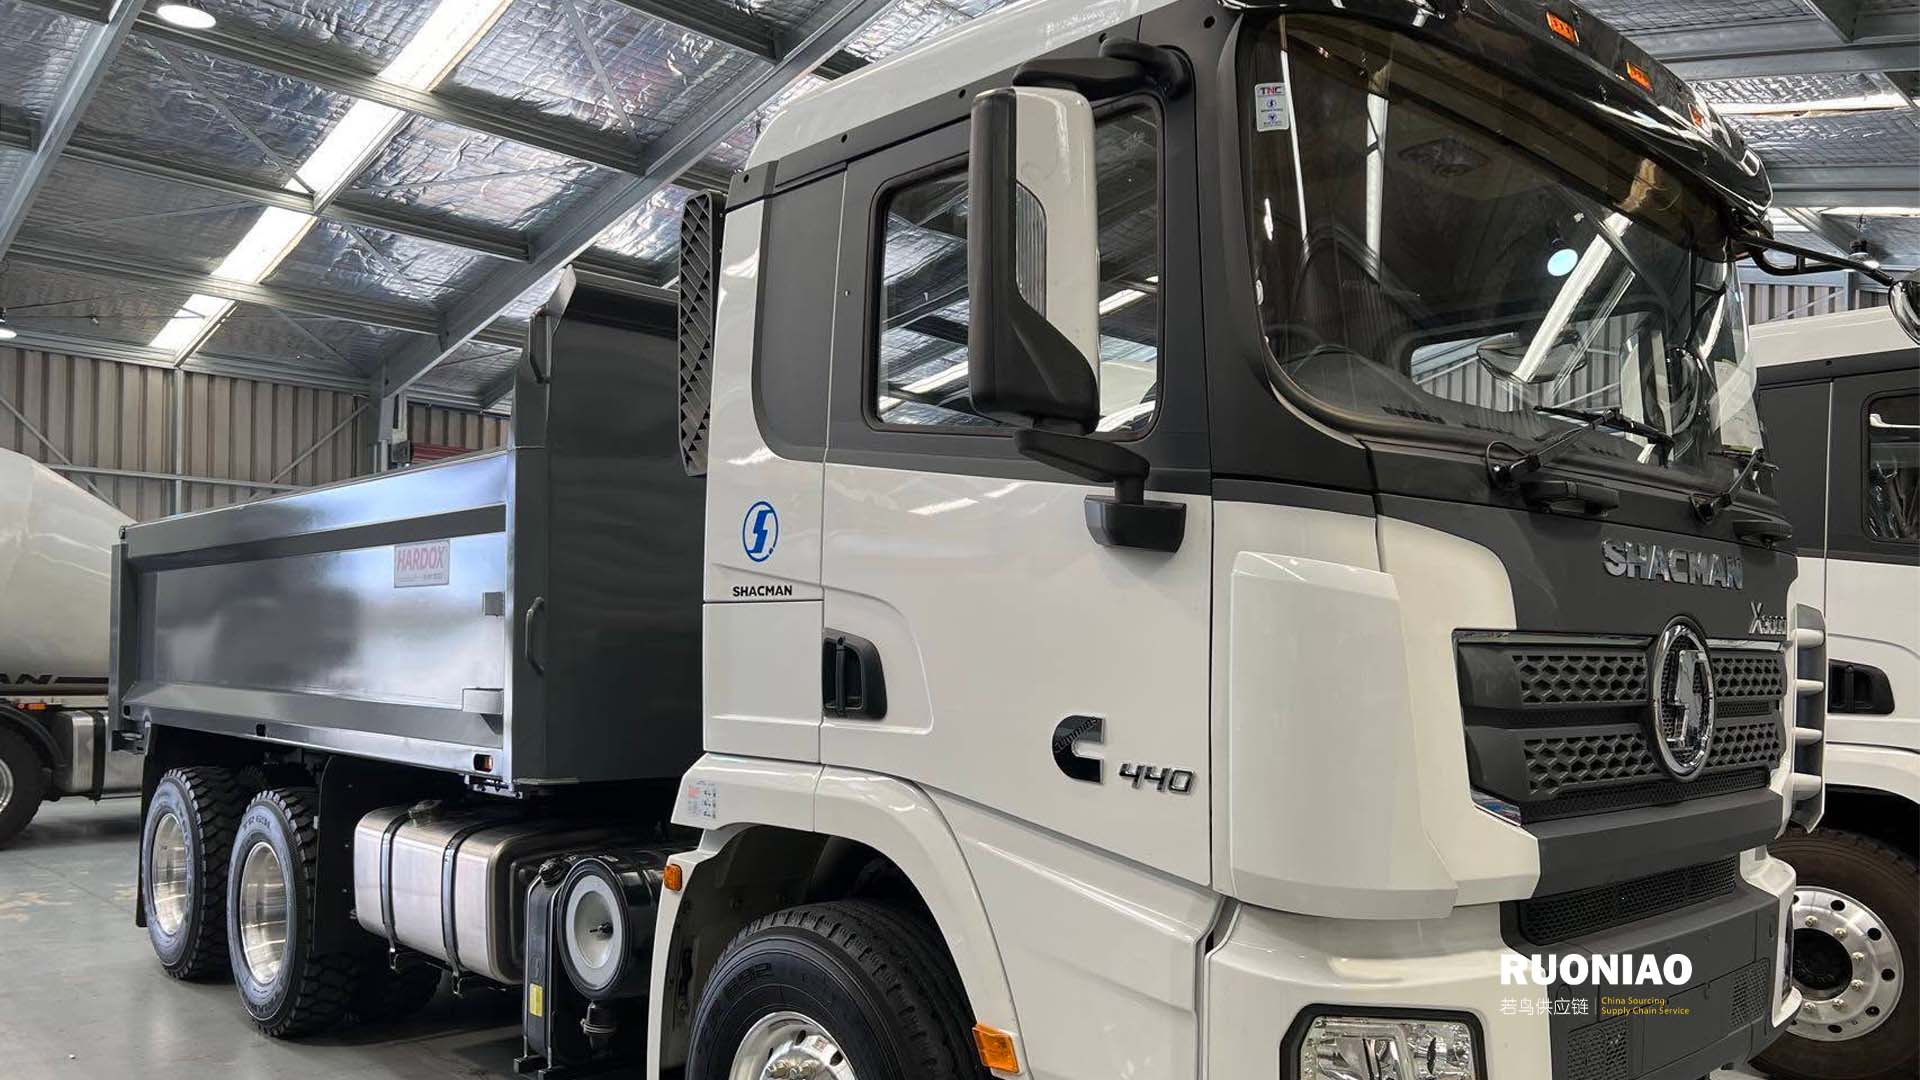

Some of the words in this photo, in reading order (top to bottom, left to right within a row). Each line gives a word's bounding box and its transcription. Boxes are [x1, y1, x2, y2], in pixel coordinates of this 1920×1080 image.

[397, 544, 443, 571] HARDOX
[1602, 539, 1744, 589] SHACMAN
[732, 585, 793, 597] SHACMAN
[1119, 763, 1194, 795] 440
